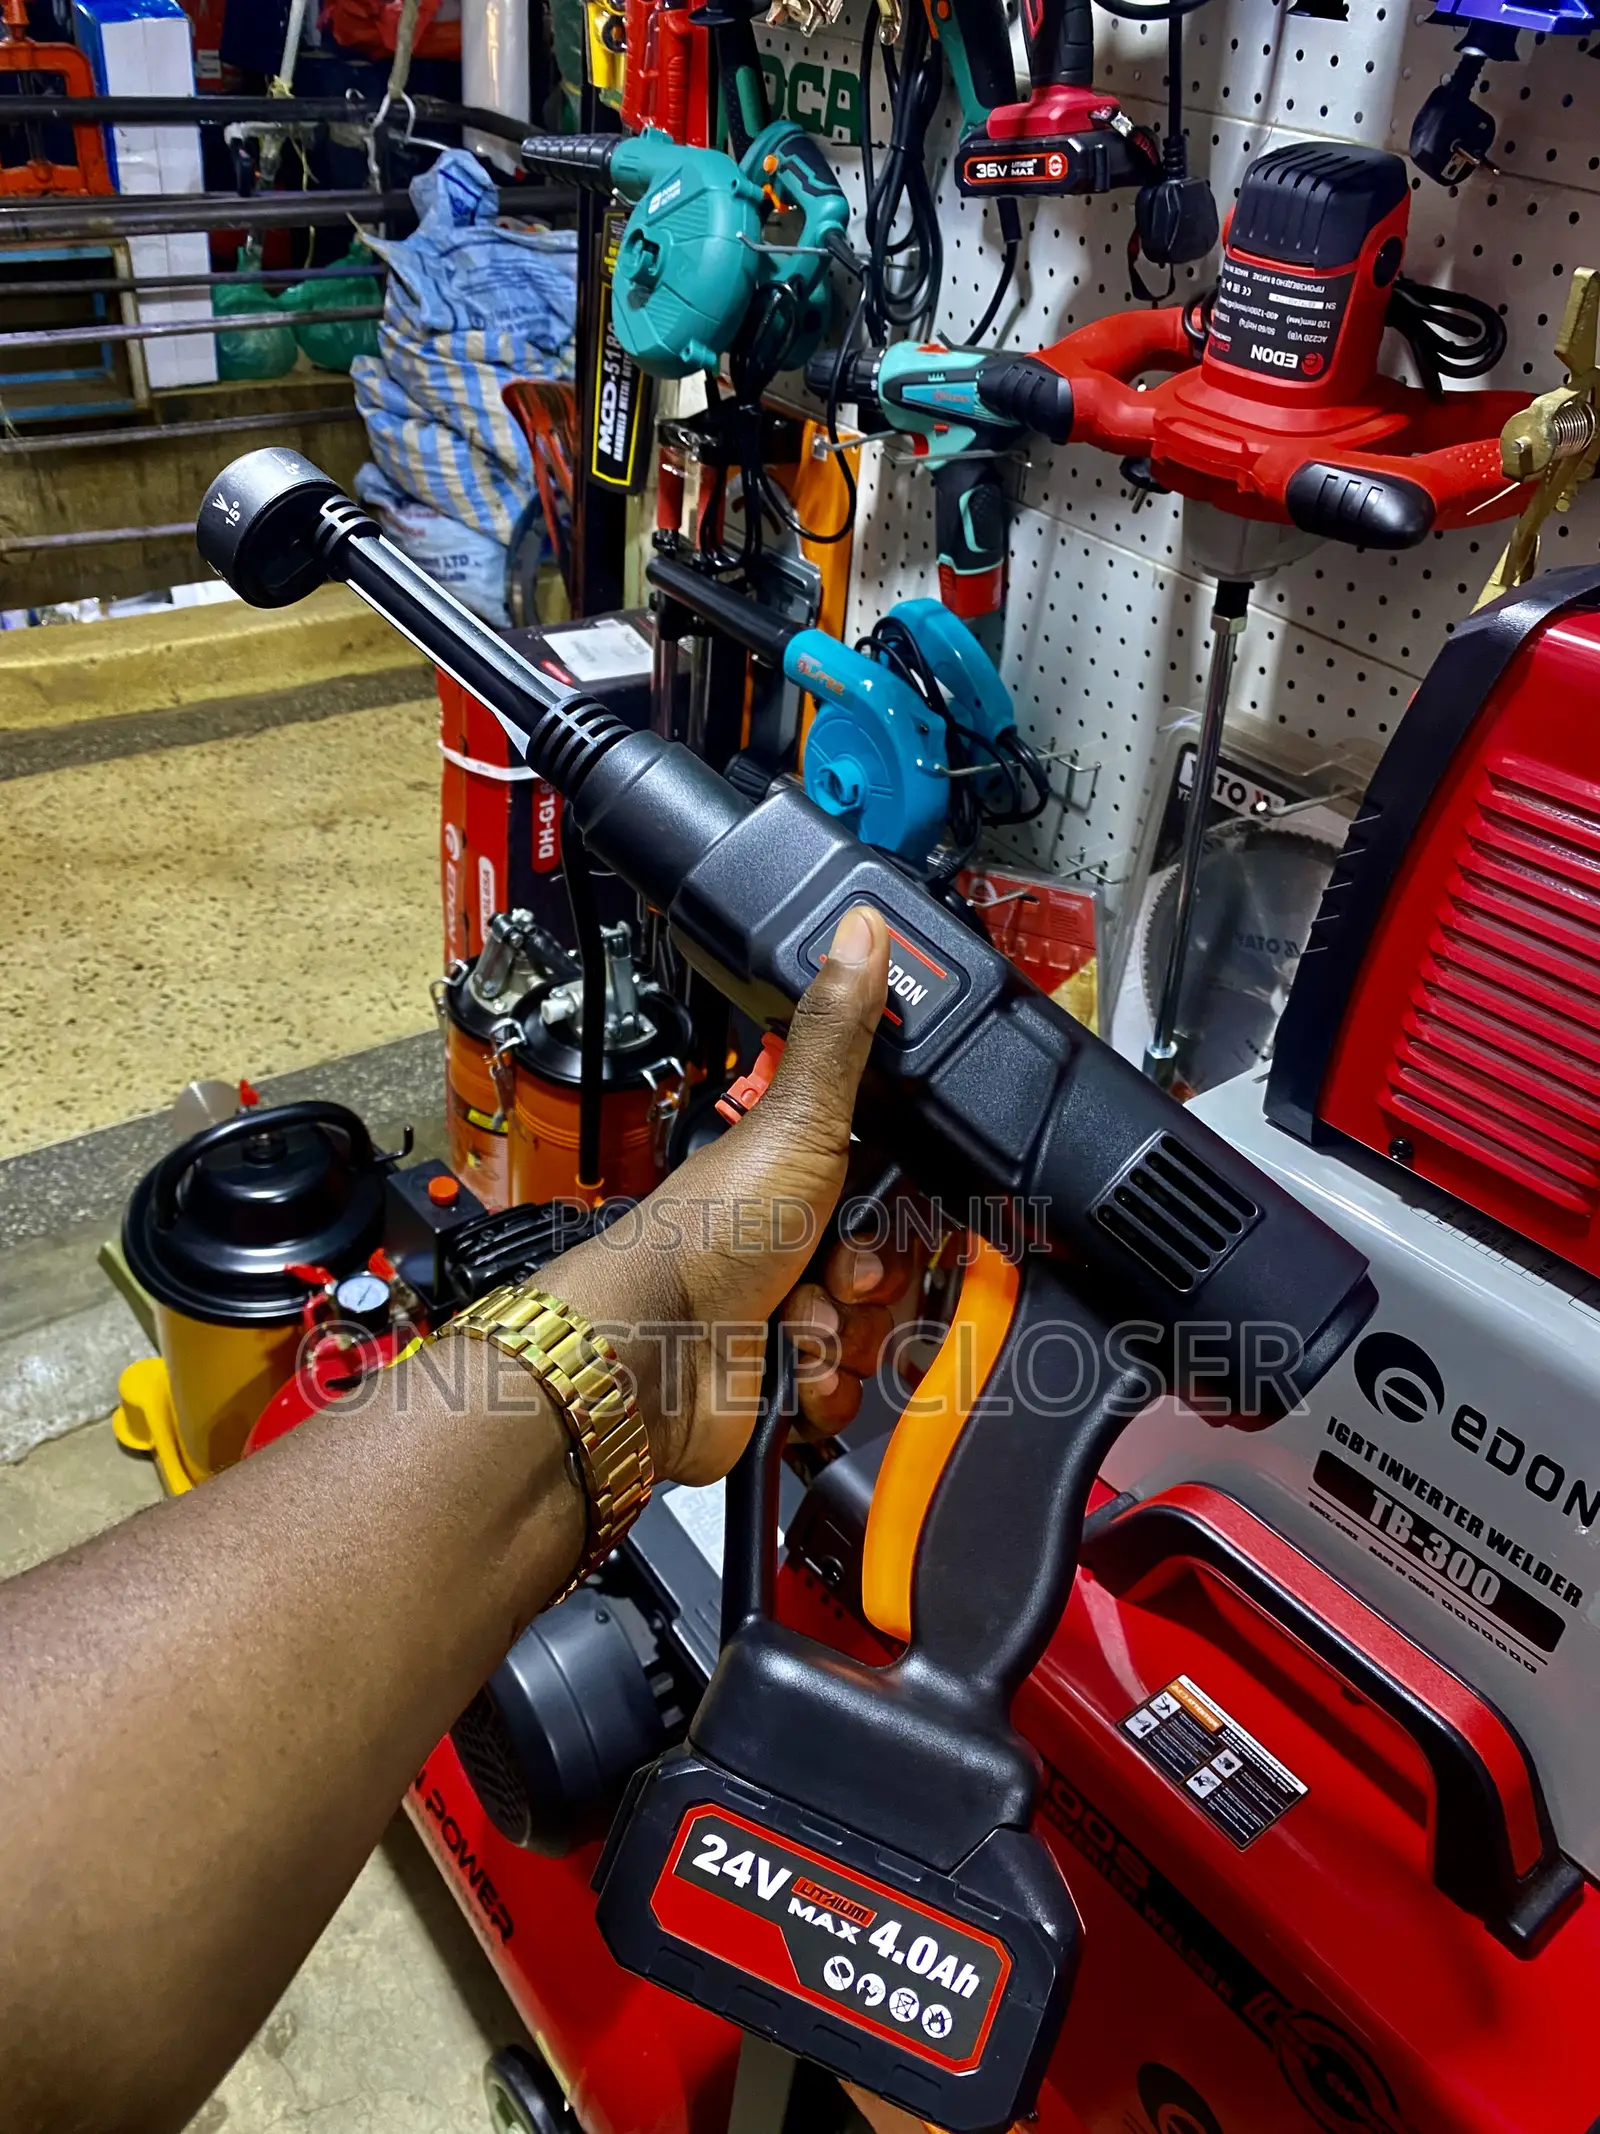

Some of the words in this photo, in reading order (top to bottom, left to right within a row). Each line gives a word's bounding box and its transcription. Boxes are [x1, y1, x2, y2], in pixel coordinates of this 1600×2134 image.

[976, 162, 1008, 178] 36V
[1011, 168, 1035, 176] MAX
[1317, 320, 1331, 329] 120
[1325, 302, 1336, 310] SN
[1250, 344, 1299, 369] EDON
[1304, 334, 1328, 343] AC220
[879, 959, 929, 1006] DON
[1326, 1416, 1379, 1463] IGBT
[1377, 1451, 1485, 1539] INVERTER
[1485, 1526, 1584, 1609] WELDER
[1368, 1489, 1501, 1606] TB-300
[1368, 1545, 1394, 1568] MADE
[1407, 1574, 1436, 1599] CHINA
[425, 1788, 514, 1943] POWER
[691, 1834, 793, 1901] 24V
[787, 1897, 862, 1945] MAX
[799, 1881, 870, 1923] LITHIUM
[868, 1920, 981, 1999] 4.0Ah
